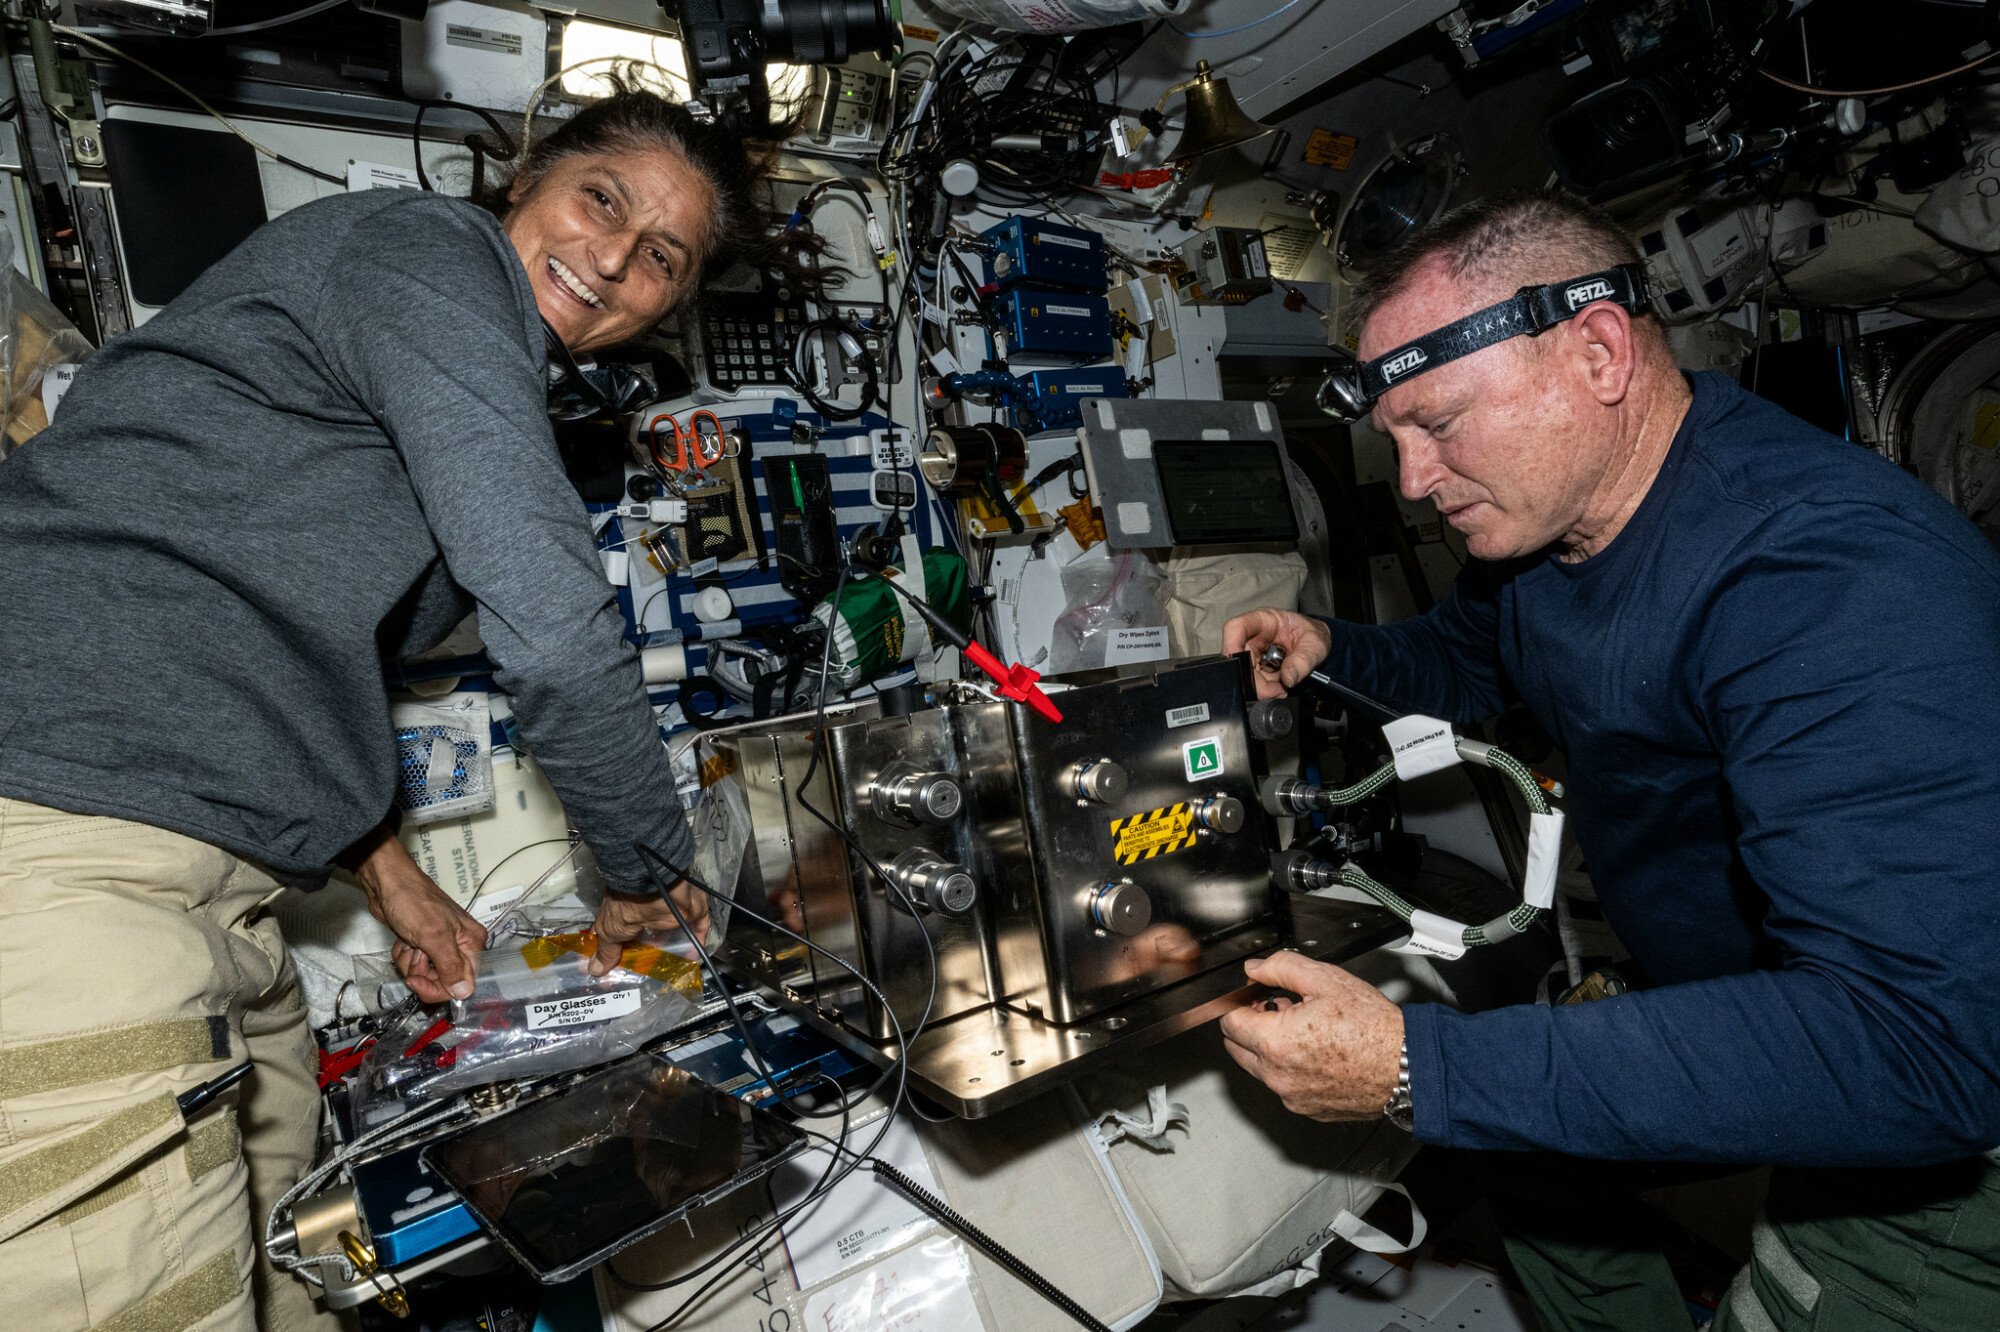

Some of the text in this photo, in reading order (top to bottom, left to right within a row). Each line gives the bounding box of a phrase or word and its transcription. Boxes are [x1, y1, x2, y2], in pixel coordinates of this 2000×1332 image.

[1567, 281, 1616, 312] PETZL
[1463, 311, 1524, 340] TIKKA
[1383, 350, 1428, 384] PETZL
[57, 371, 71, 381] Wet
[1119, 632, 1129, 640] Dry
[1130, 631, 1145, 639] Wipes
[1413, 737, 1425, 745] Hose
[1424, 733, 1435, 741] Flex
[1123, 833, 1136, 841] PARTS
[1145, 825, 1170, 836] ASSEMBLIES
[1129, 821, 1160, 834] CAUTION
[418, 825, 432, 854] LEAK
[1124, 838, 1144, 847] SENSITIVE
[1125, 834, 1179, 853] ELECTROSTATIC DISCHARGE
[452, 848, 468, 894] STATION
[533, 1003, 557, 1015] Day
[560, 997, 607, 1010] Glasses
[612, 992, 625, 1000] Qty
[562, 1008, 595, 1018] R2D2-DV
[837, 1229, 865, 1248] 0.5 CTB
